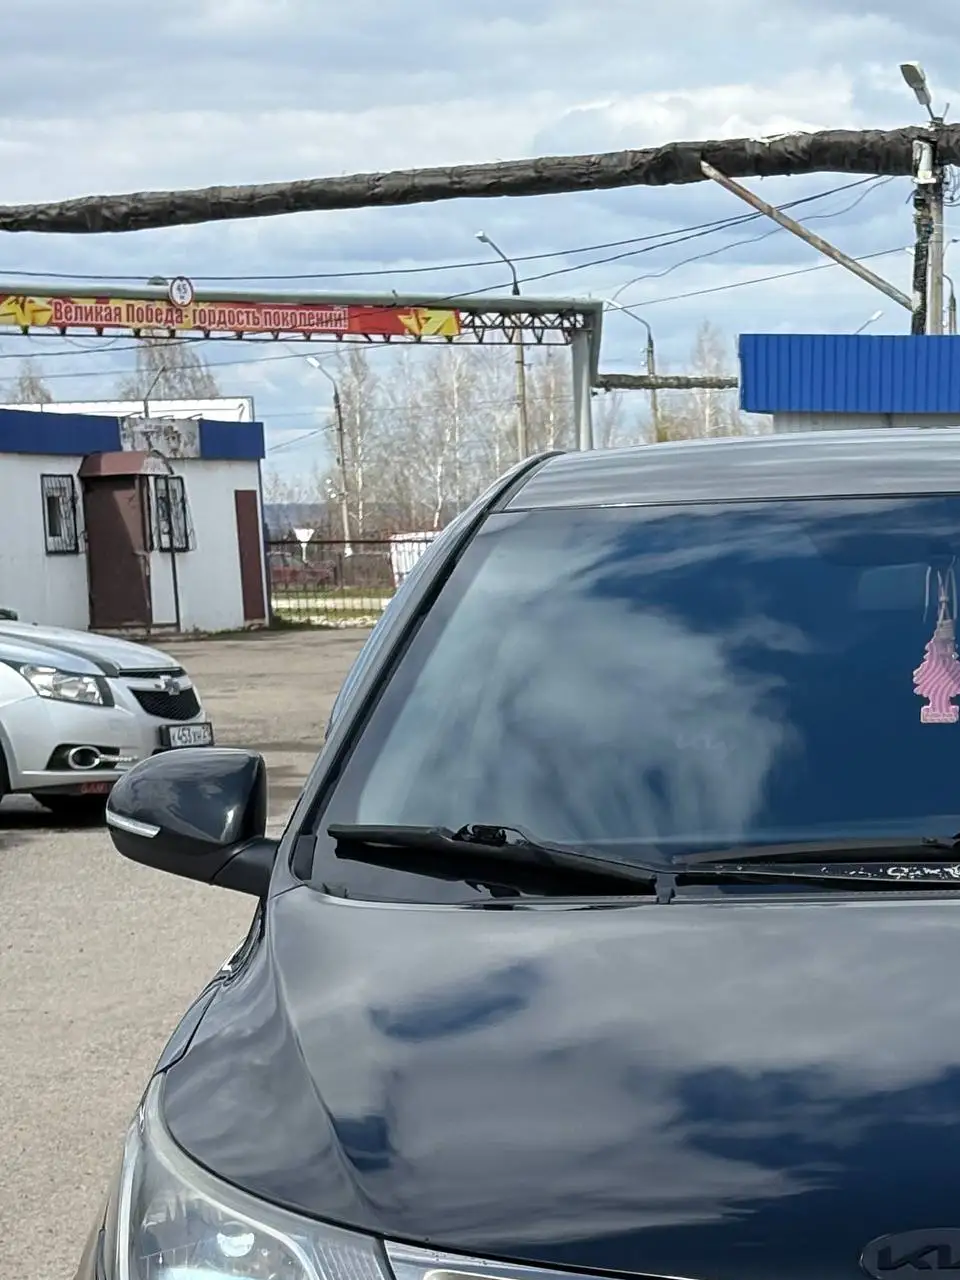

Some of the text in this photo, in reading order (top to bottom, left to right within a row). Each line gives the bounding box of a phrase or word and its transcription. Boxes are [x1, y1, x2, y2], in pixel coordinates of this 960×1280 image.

[53, 300, 122, 323] Великая
[192, 307, 260, 328] гордость
[263, 308, 348, 329] поколений!
